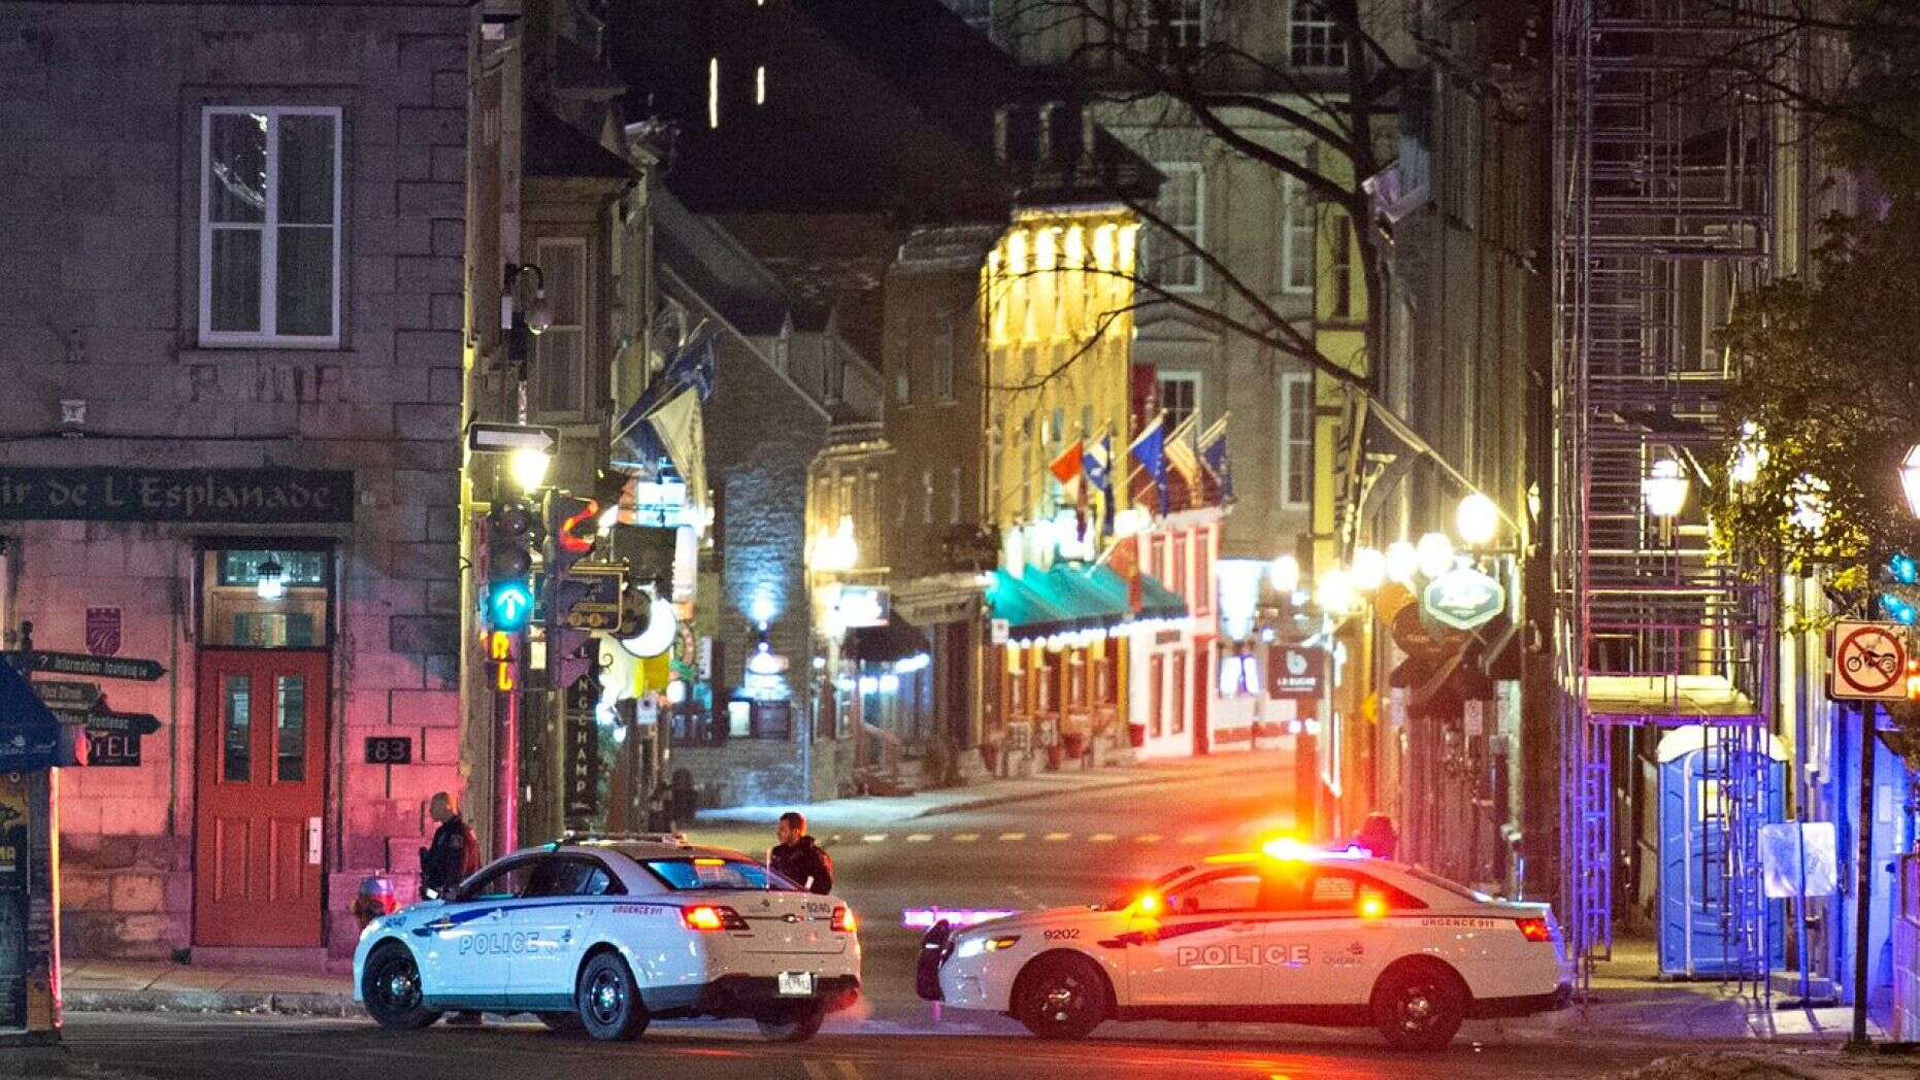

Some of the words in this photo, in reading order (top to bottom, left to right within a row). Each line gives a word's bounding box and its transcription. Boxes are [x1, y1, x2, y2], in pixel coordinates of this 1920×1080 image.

[375, 741, 406, 761] 83
[1421, 918, 1476, 927] URGENCE
[1478, 919, 1495, 928] 911
[459, 931, 540, 956] POLICE
[1043, 929, 1080, 941] 9202
[1177, 944, 1311, 967] POLICE
